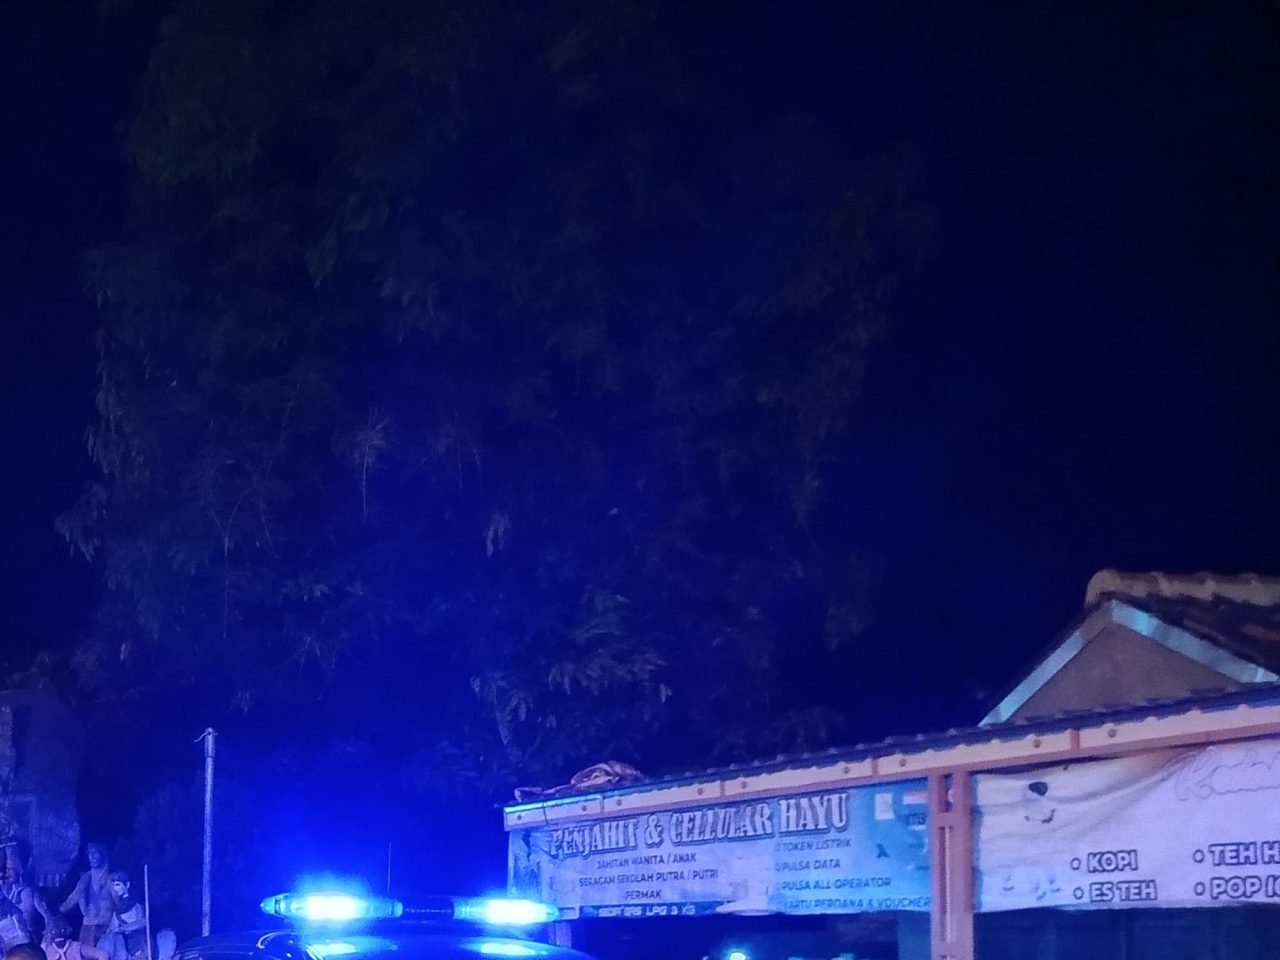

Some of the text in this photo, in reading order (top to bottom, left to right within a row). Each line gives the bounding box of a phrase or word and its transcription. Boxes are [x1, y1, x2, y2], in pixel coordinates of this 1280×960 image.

[549, 792, 850, 859] PENJAHIT & CELLULAR HAYU
[631, 854, 665, 865] WANITA
[1207, 842, 1258, 866] TEH
[782, 858, 841, 871] PULSA DATA
[1087, 850, 1138, 873] KOPI
[656, 870, 685, 881] PUTRA
[692, 868, 719, 880] PUTRI
[782, 877, 892, 891] PULSA ALL OPERATOR
[1089, 879, 1158, 902] ES TEH
[1210, 874, 1262, 899] POP
[625, 889, 662, 901] PERMAK
[646, 905, 668, 916] LPG
[671, 904, 679, 916] 3
